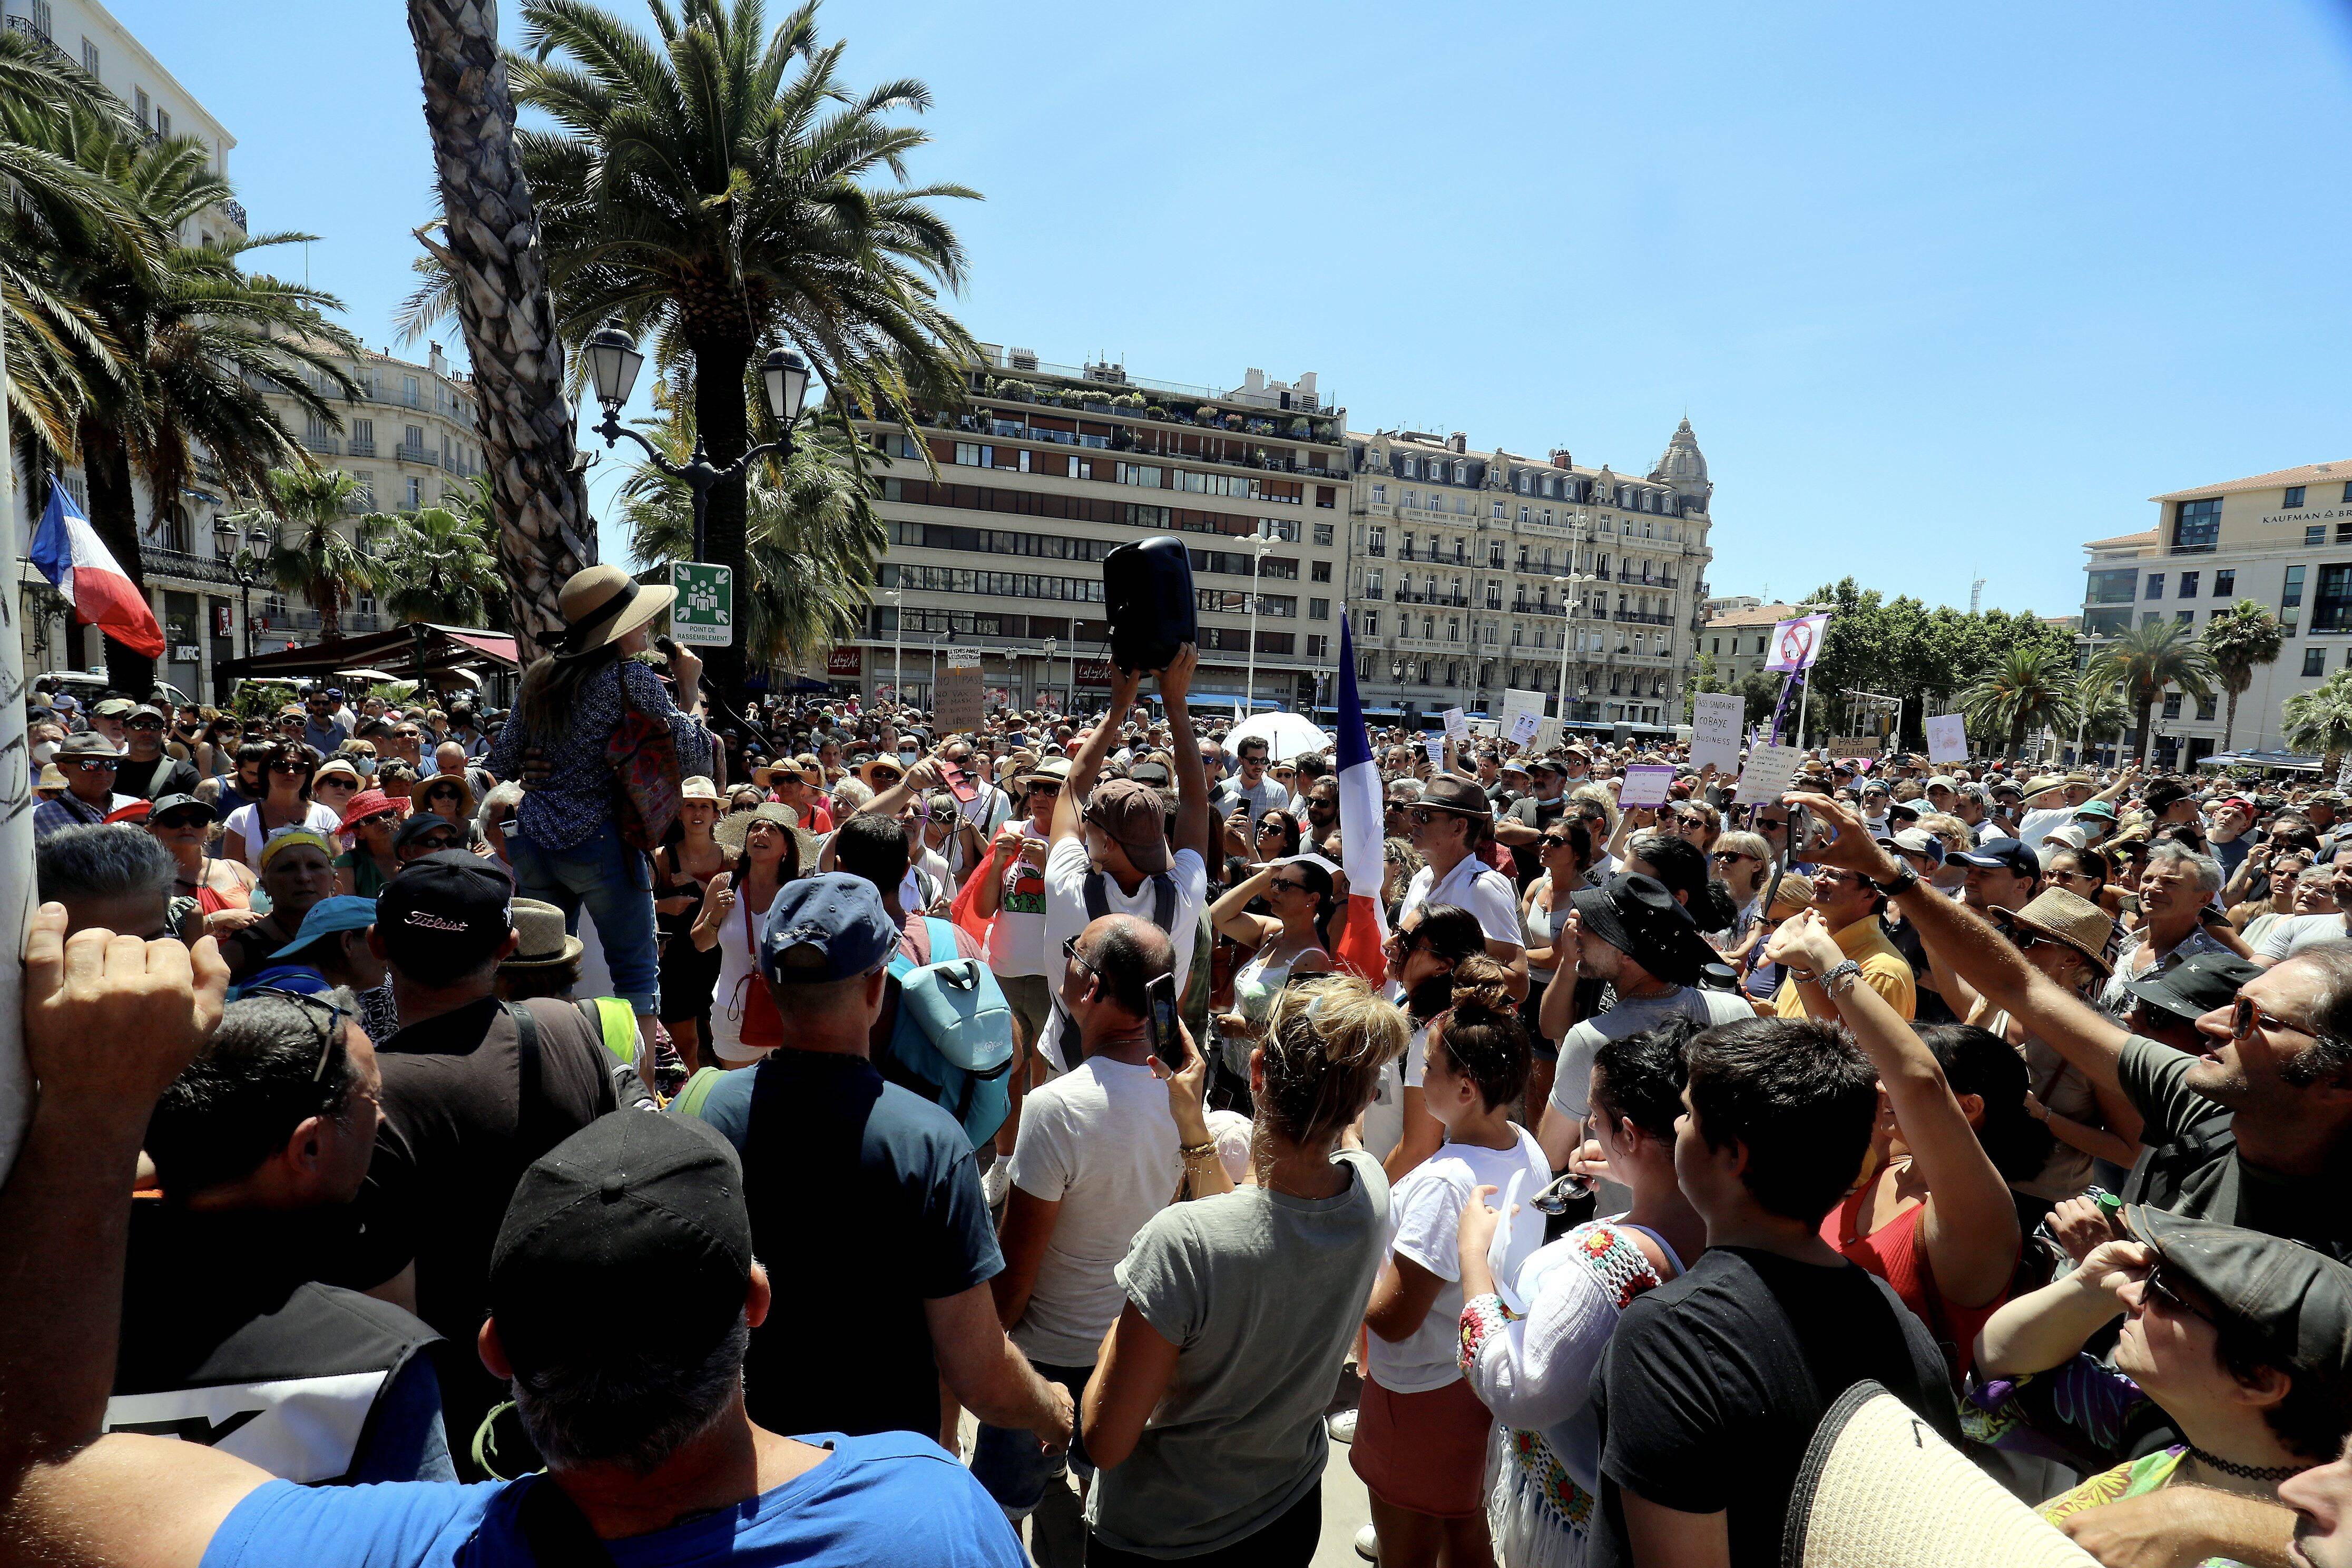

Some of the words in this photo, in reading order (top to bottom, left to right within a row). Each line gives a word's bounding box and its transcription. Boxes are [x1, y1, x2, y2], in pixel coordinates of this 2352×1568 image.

[2263, 512, 2320, 523] KAUFMAN
[677, 633, 728, 642] RASSEMBLEMENT
[175, 645, 199, 660] KFC
[936, 677, 949, 685] NO
[962, 675, 983, 684] PASS
[1696, 696, 1708, 708] PASS
[1710, 700, 1736, 711] SANITAIRE
[1699, 717, 1728, 728] COBAYE
[1857, 747, 1880, 756] HONTE
[404, 910, 468, 932] Titleist
